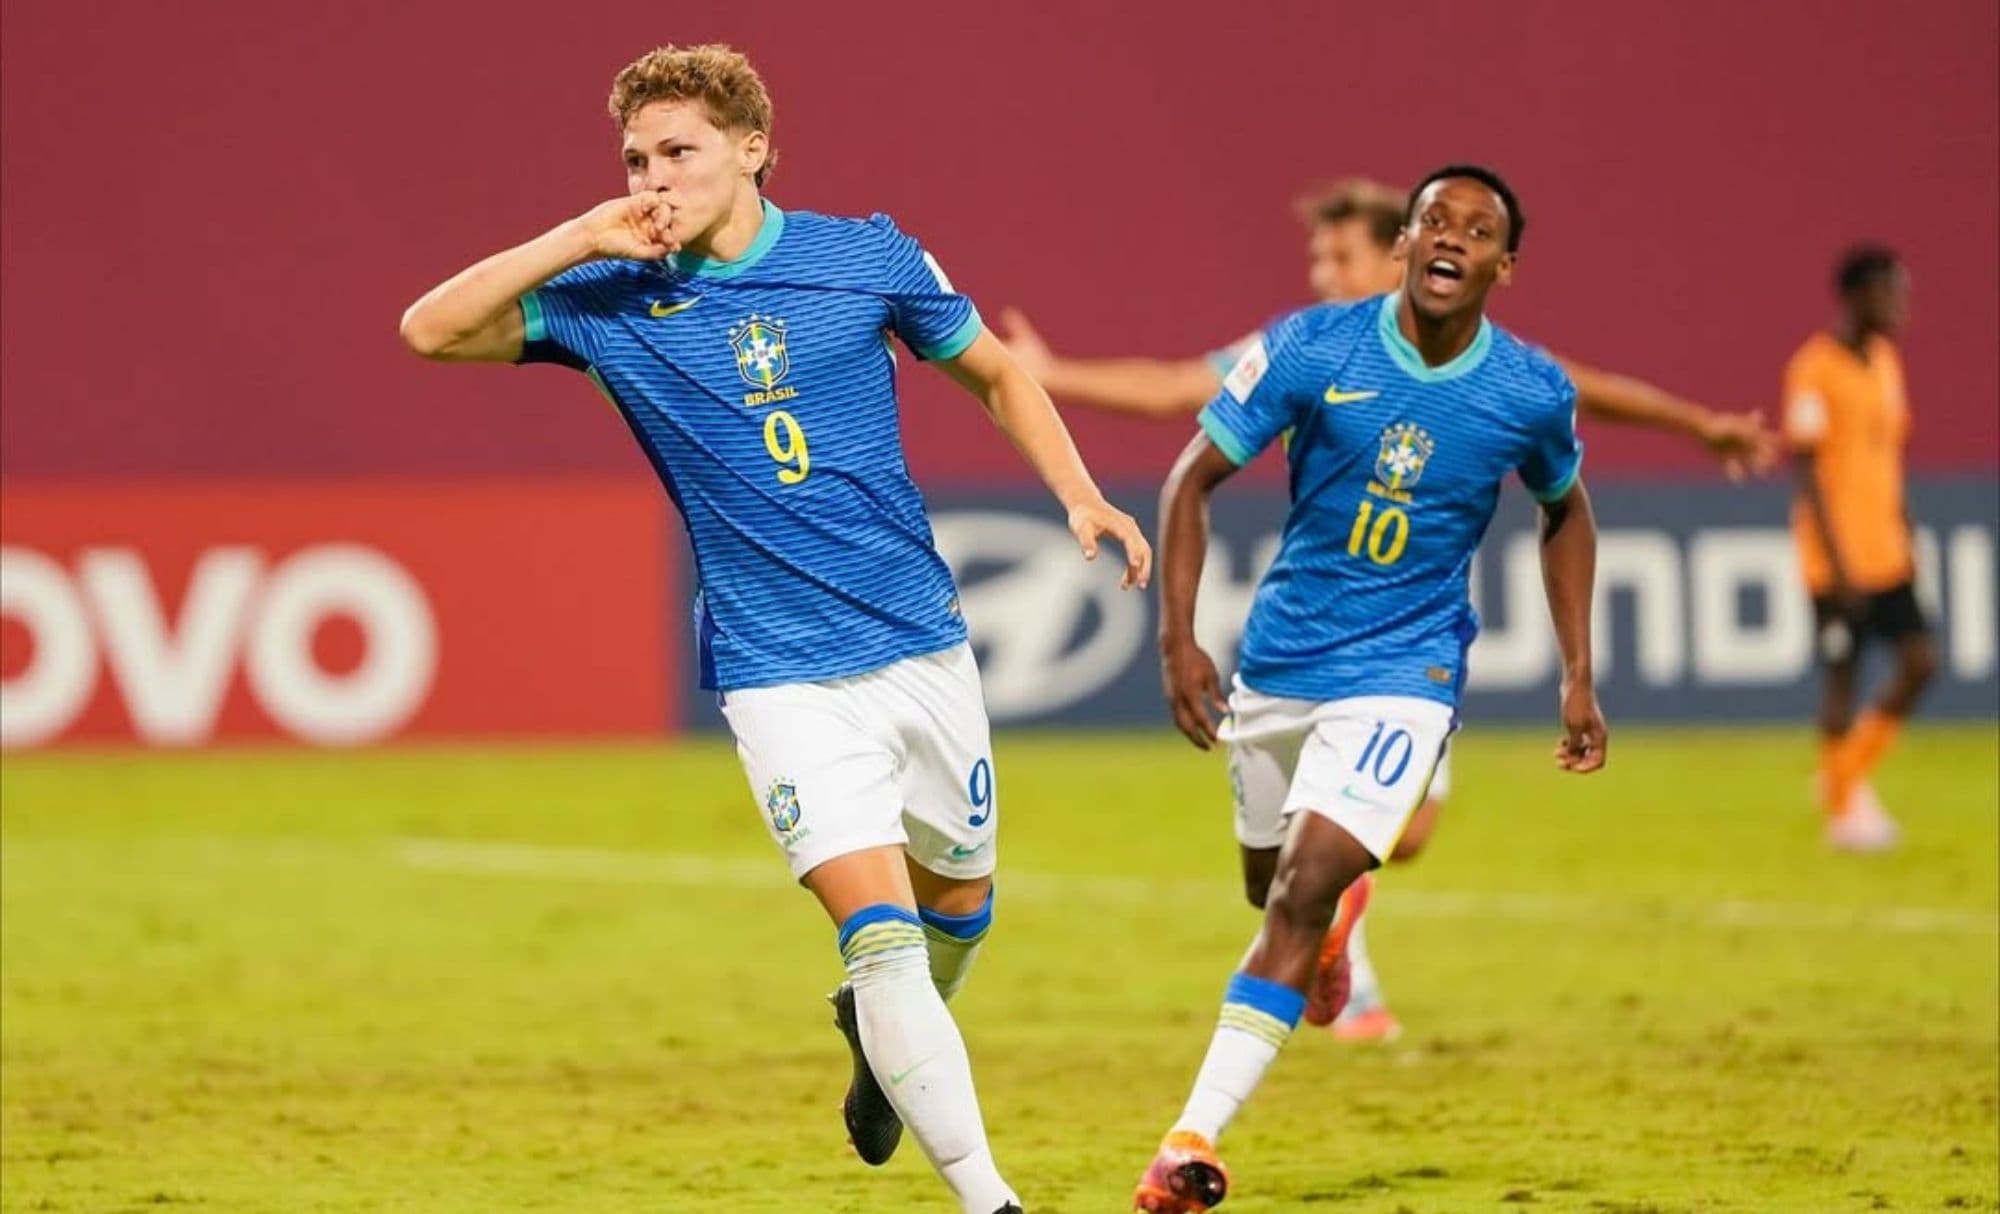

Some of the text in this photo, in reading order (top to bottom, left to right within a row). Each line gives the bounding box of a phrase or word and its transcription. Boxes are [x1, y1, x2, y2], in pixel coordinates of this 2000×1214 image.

[743, 386, 800, 407] BRASIL
[763, 410, 811, 485] 9
[1347, 500, 1409, 565] 10
[1354, 720, 1412, 787] 10
[968, 757, 992, 827] 9
